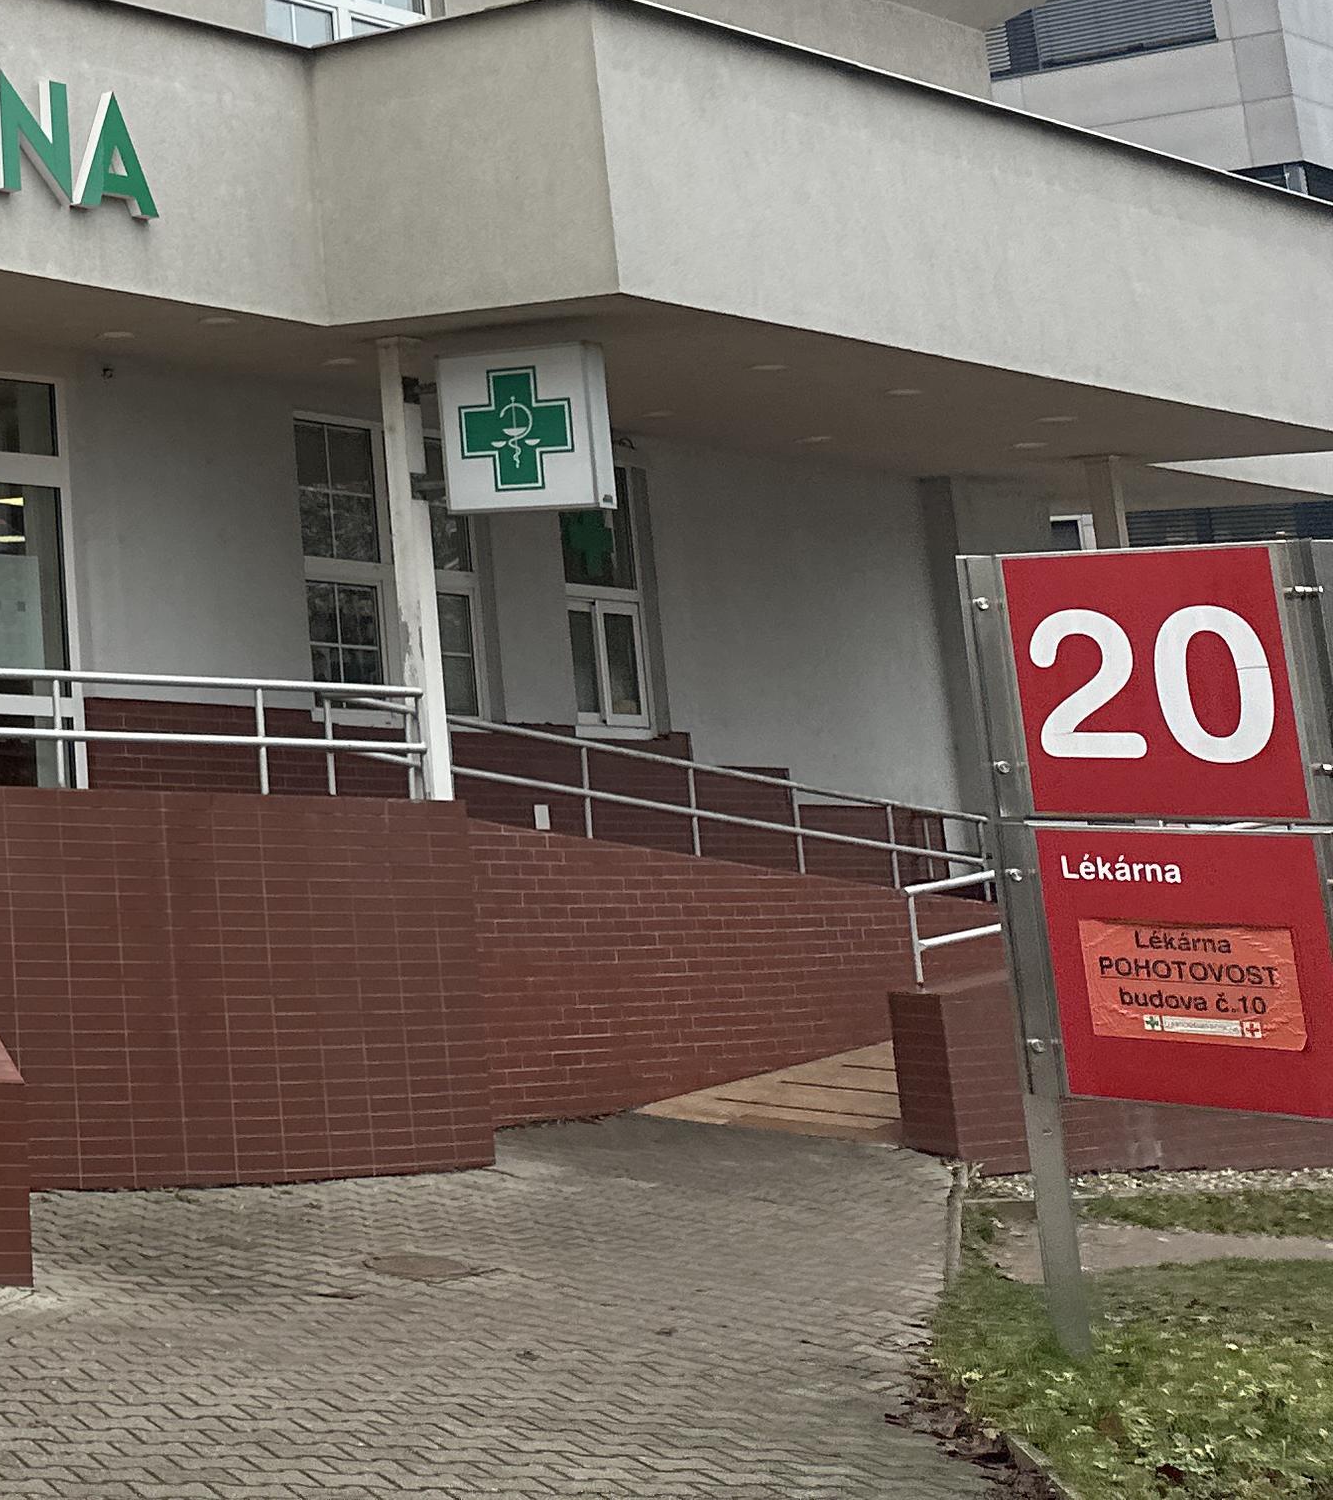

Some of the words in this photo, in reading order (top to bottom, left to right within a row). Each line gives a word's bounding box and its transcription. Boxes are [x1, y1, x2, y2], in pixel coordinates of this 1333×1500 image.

[1029, 604, 1275, 764] 20
[1060, 853, 1182, 884] Lékárna
[1134, 930, 1232, 954] Lékárna
[1099, 956, 1280, 986] POHOTOVOST
[1119, 987, 1208, 1012] budova
[1215, 992, 1267, 1015] č.10
